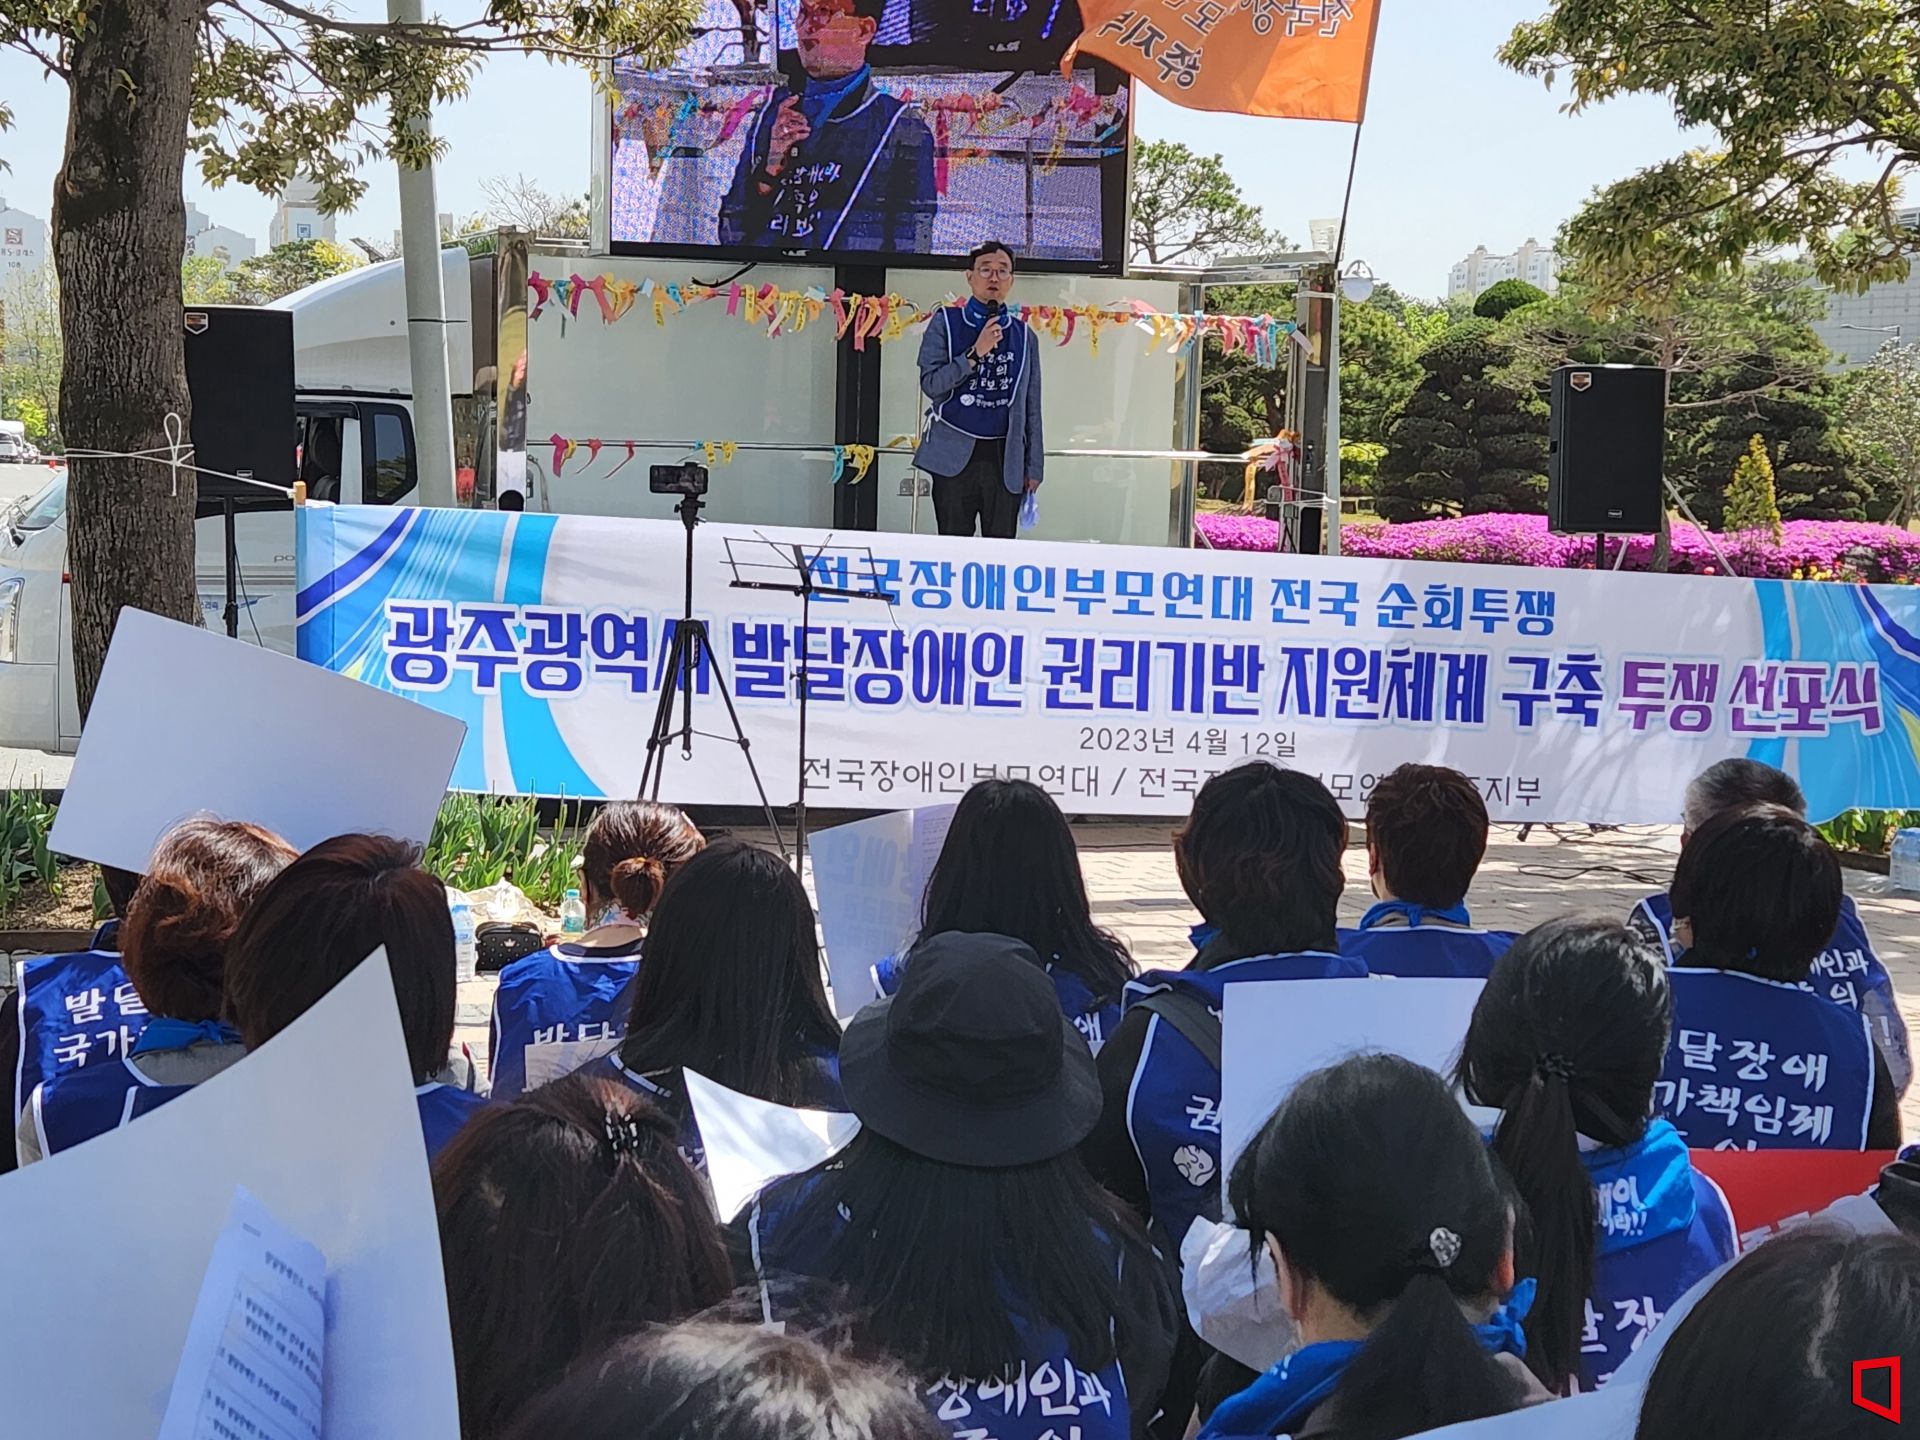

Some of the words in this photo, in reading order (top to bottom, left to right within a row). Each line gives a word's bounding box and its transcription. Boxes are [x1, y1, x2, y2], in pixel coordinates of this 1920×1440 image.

[803, 555, 1252, 621] 전국장애인부모연대
[1271, 578, 1360, 627] 전국
[1377, 583, 1556, 636] 순회투쟁
[388, 605, 710, 695] 광주광역시
[732, 622, 1024, 707] 발달장애인
[1041, 637, 1265, 716] 권리기반
[1278, 646, 1489, 723] 지원체계
[1502, 653, 1603, 728] 구축
[1617, 660, 1719, 732] 투쟁
[1728, 665, 1882, 732] 선포식
[1080, 727, 1174, 754] 2023년
[1186, 729, 1227, 756] 4월
[1240, 731, 1296, 758] 12일
[53, 1024, 147, 1067] 국가
